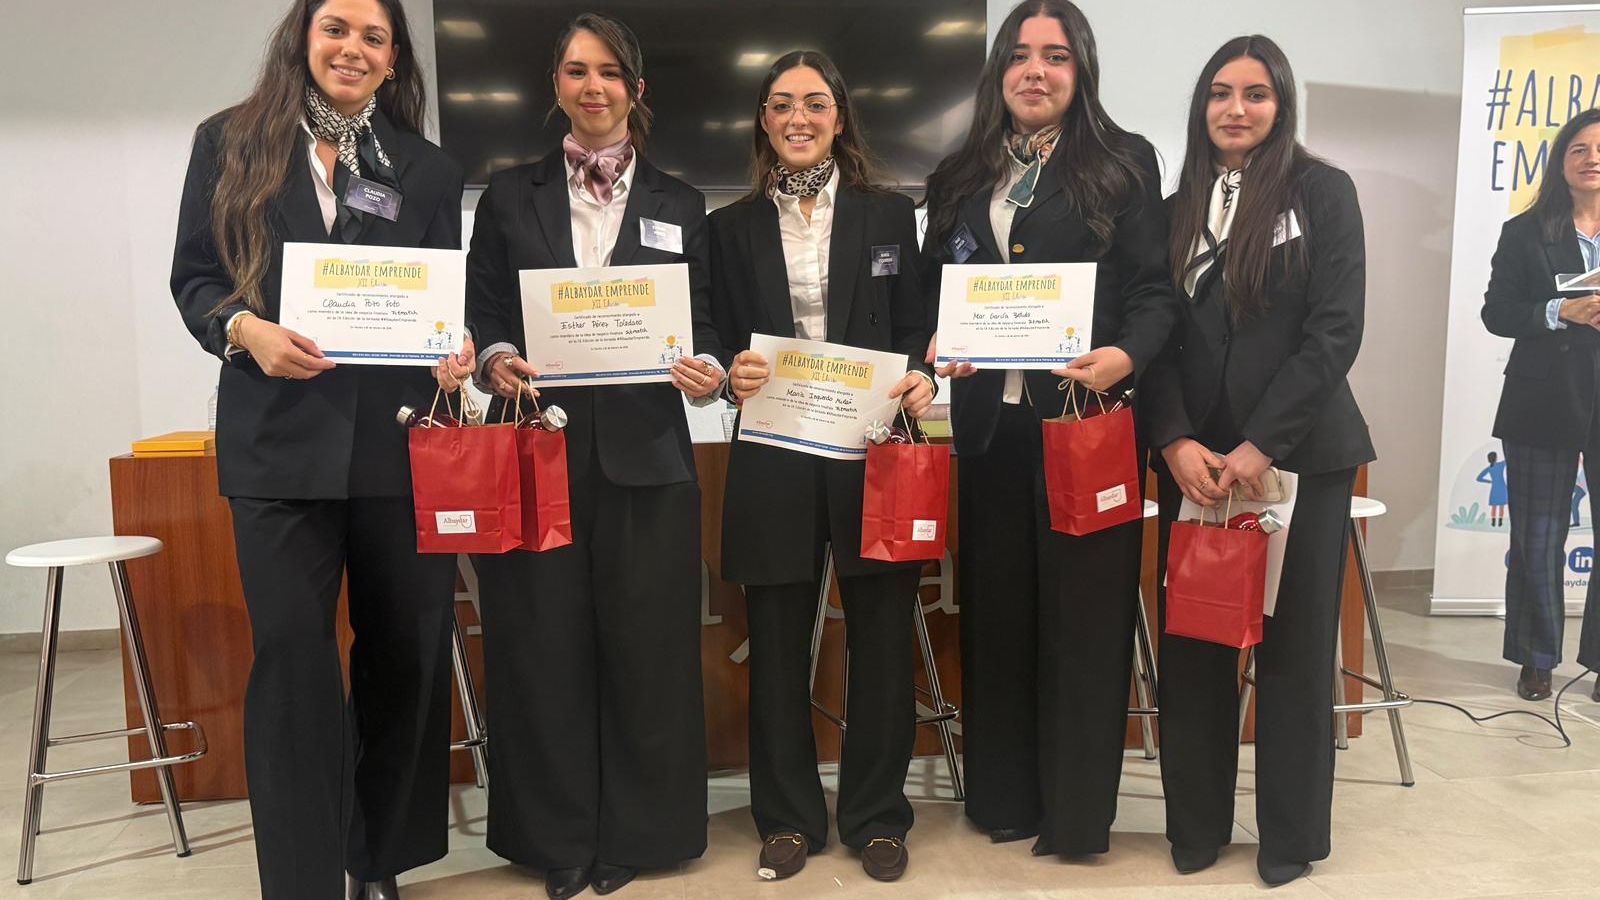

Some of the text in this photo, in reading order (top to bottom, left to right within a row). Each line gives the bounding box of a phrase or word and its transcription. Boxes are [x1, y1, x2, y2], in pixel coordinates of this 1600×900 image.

[364, 188, 386, 198] CLAUDIA
[365, 194, 380, 202] POZO
[322, 263, 422, 278] #ALBAYDAR EMPRENDE
[974, 279, 1056, 291] #ALBAYDAR EMPRENDE
[559, 284, 649, 300] #ALBAYDAR EMPRENDE
[973, 312, 985, 320] Mar
[560, 321, 585, 329] Esther
[782, 354, 868, 378] #ALBAYDAR EMPRENDE
